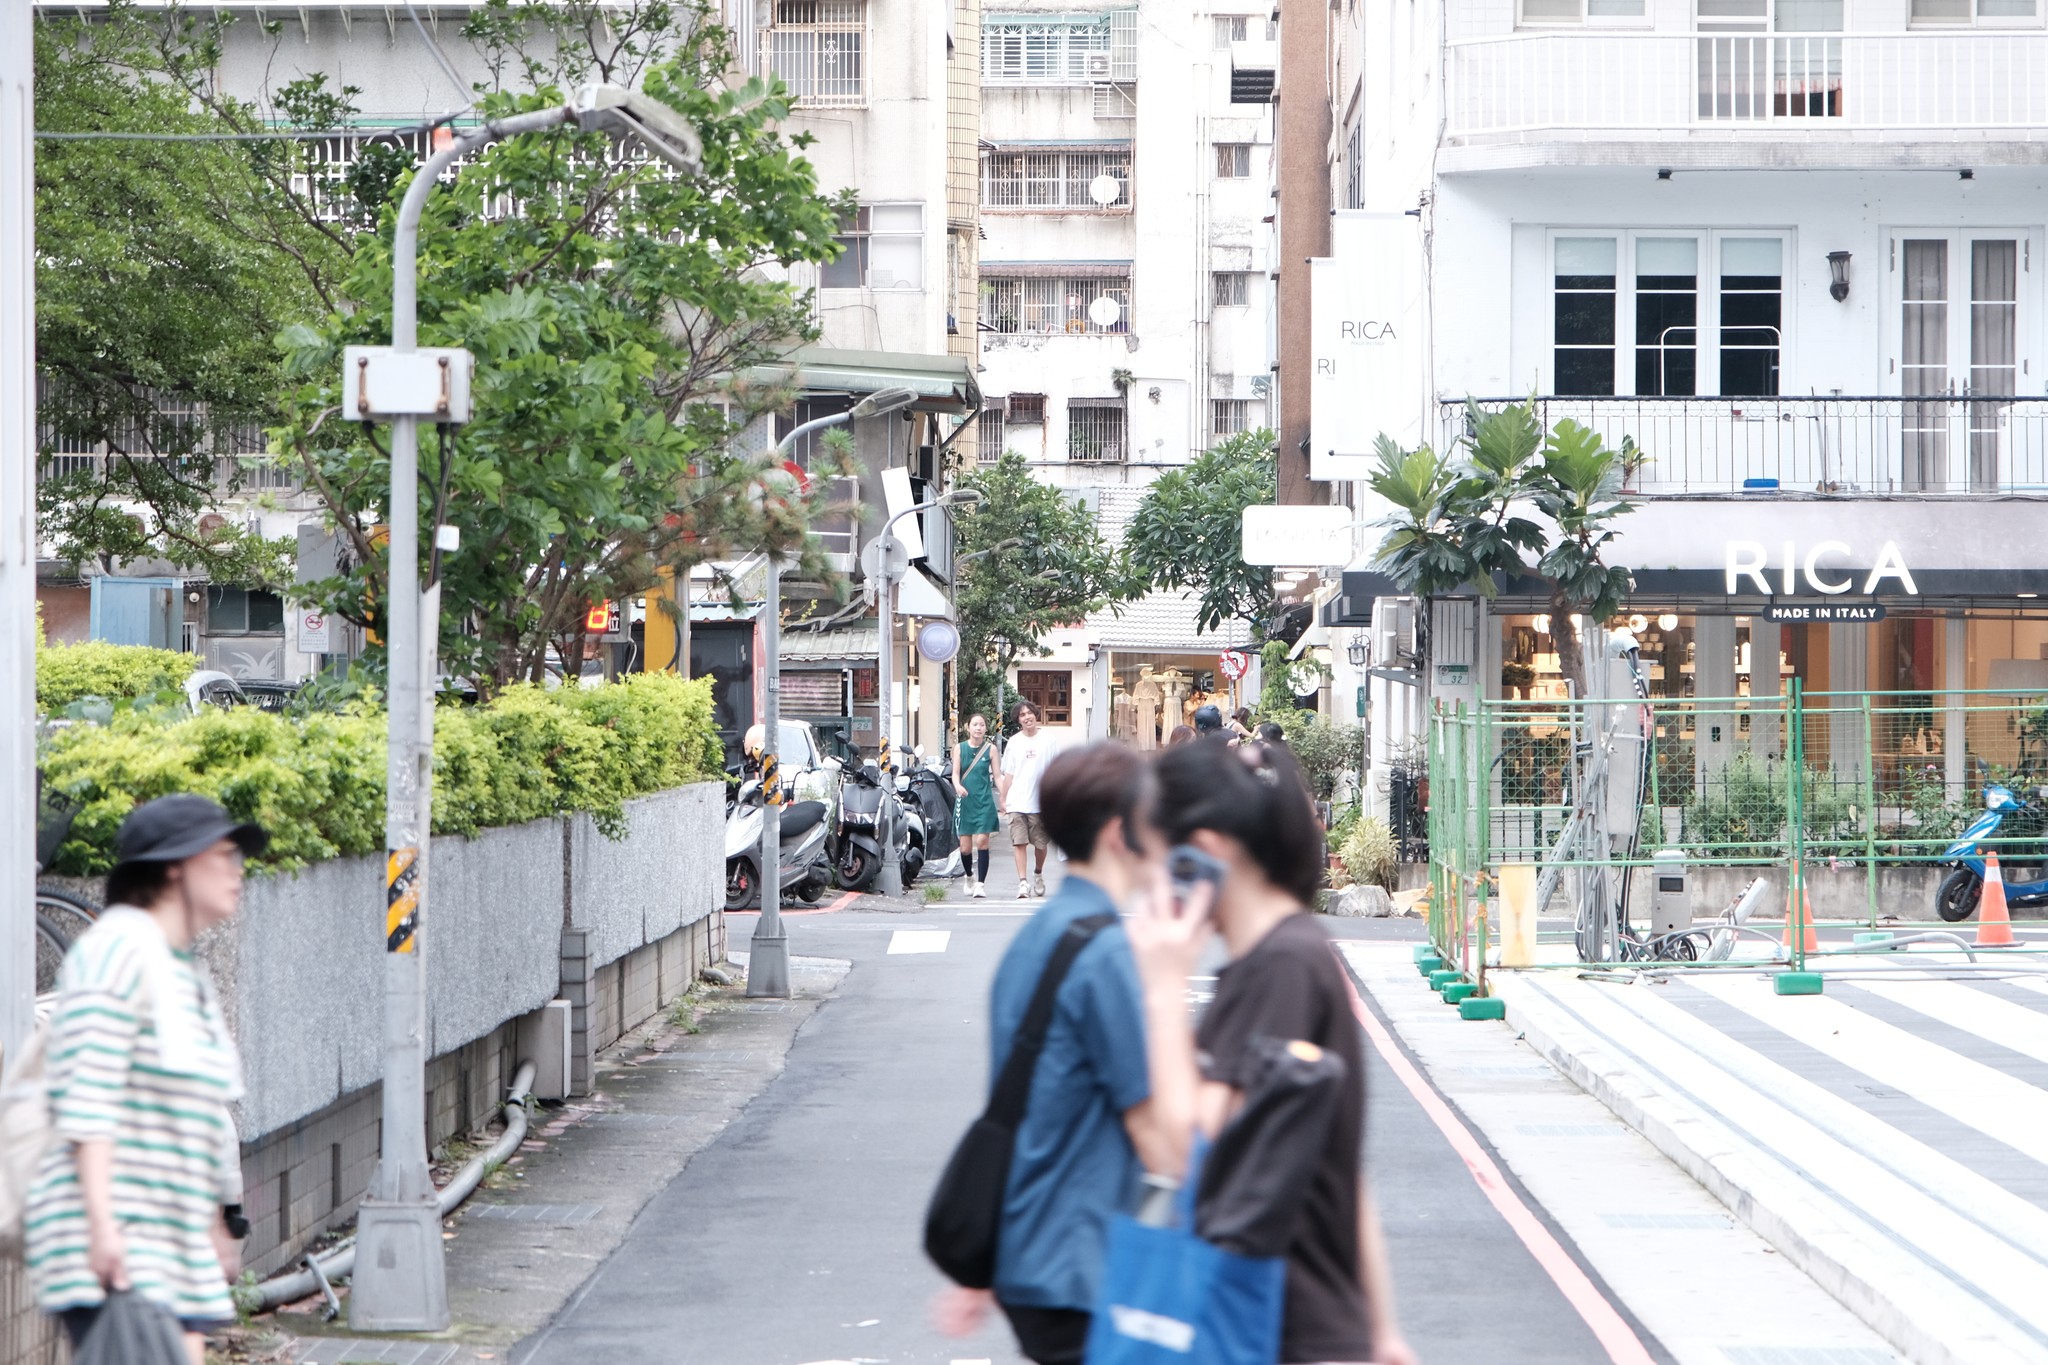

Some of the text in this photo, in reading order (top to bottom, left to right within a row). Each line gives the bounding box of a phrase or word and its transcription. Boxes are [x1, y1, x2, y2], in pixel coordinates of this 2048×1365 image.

[1341, 320, 1397, 340] RICA
[1317, 358, 1336, 375] RI
[1726, 540, 1918, 595] RICA
[1772, 608, 1877, 619] MADE IN ITALY
[1451, 675, 1463, 684] 32
[856, 722, 869, 730] 29
